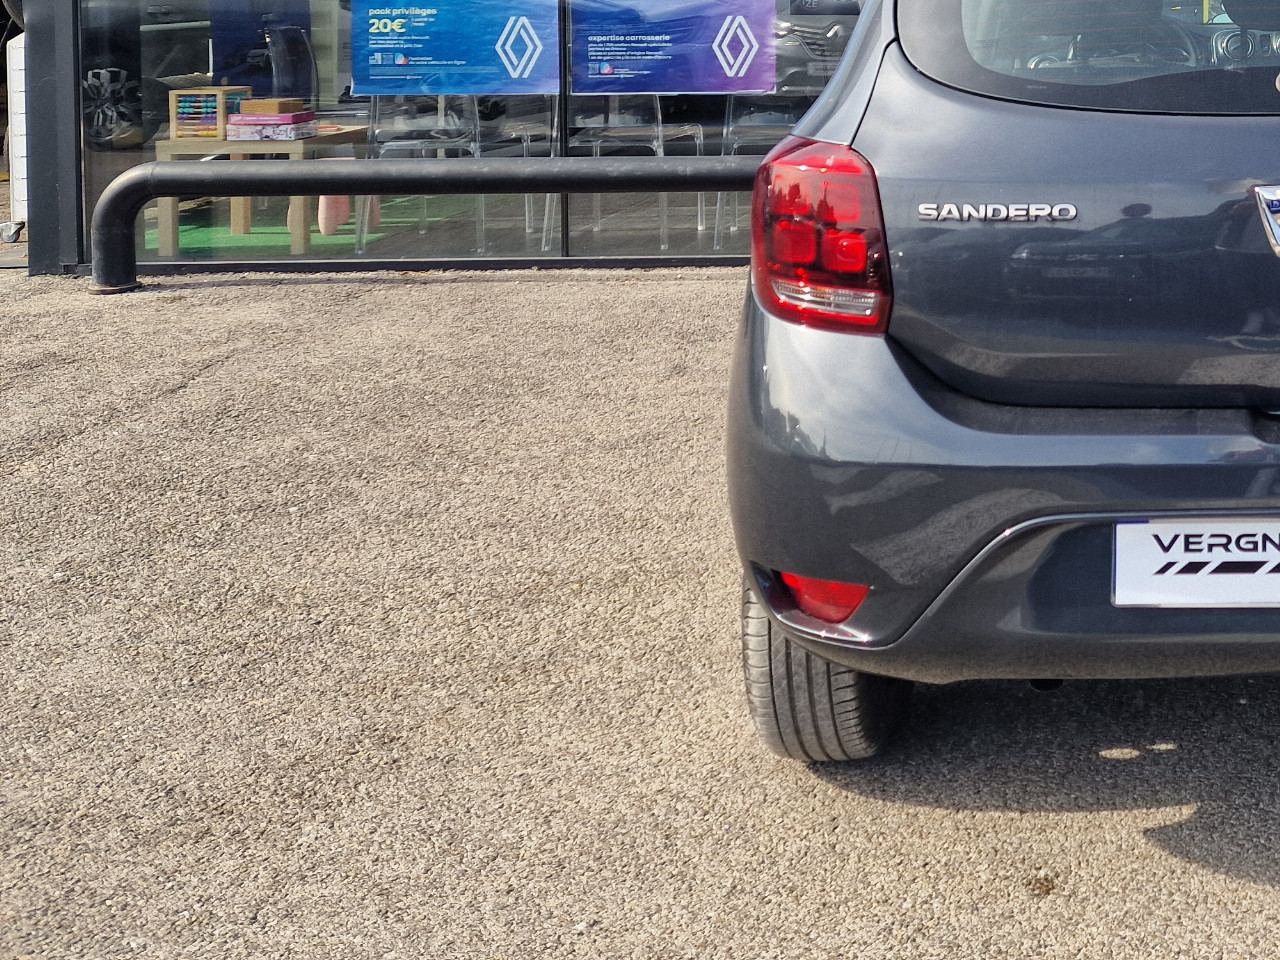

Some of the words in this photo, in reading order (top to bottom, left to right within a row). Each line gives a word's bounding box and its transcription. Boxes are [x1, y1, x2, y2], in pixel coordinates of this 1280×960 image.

[368, 7, 391, 16] pack
[368, 18, 407, 33] 20€
[587, 34, 625, 42] expertise
[625, 33, 671, 41] carrosserie
[918, 202, 1077, 223] SANDERO
